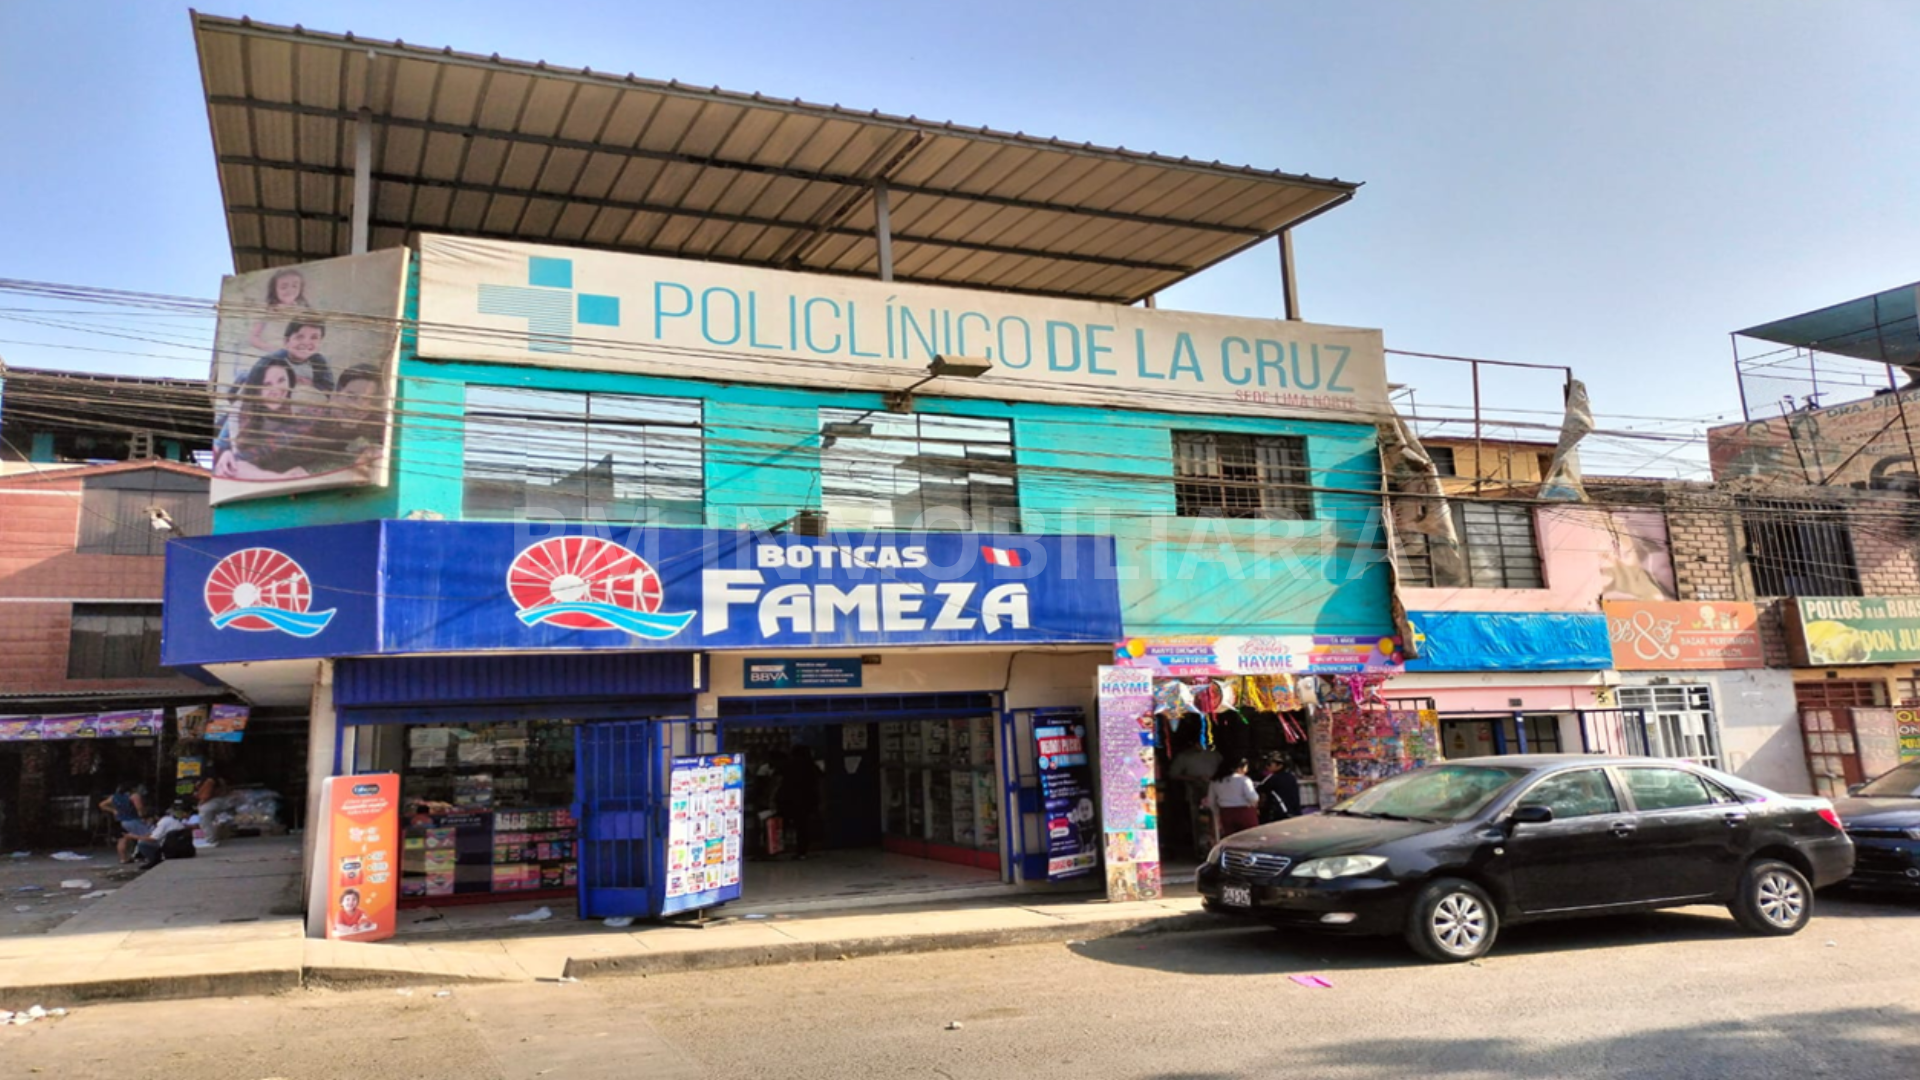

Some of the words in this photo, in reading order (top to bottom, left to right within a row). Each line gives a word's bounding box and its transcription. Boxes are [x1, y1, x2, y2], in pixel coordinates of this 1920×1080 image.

[654, 281, 1032, 369] POLICLÍNICO
[1046, 320, 1117, 376] DE
[1135, 328, 1204, 382] LA
[1220, 336, 1355, 393] CRUZ
[1275, 392, 1309, 408] LIMA
[1312, 395, 1357, 411] NORTE
[1826, 404, 1868, 418] DRA.
[756, 545, 927, 569] BOTICAS
[702, 568, 1030, 639] FAMEZA
[1805, 600, 1863, 620] POLLOS
[1861, 630, 1896, 652] DON
[1238, 655, 1293, 668] HAYME
[750, 672, 789, 682] BBVA
[1102, 682, 1150, 693] HAYME
